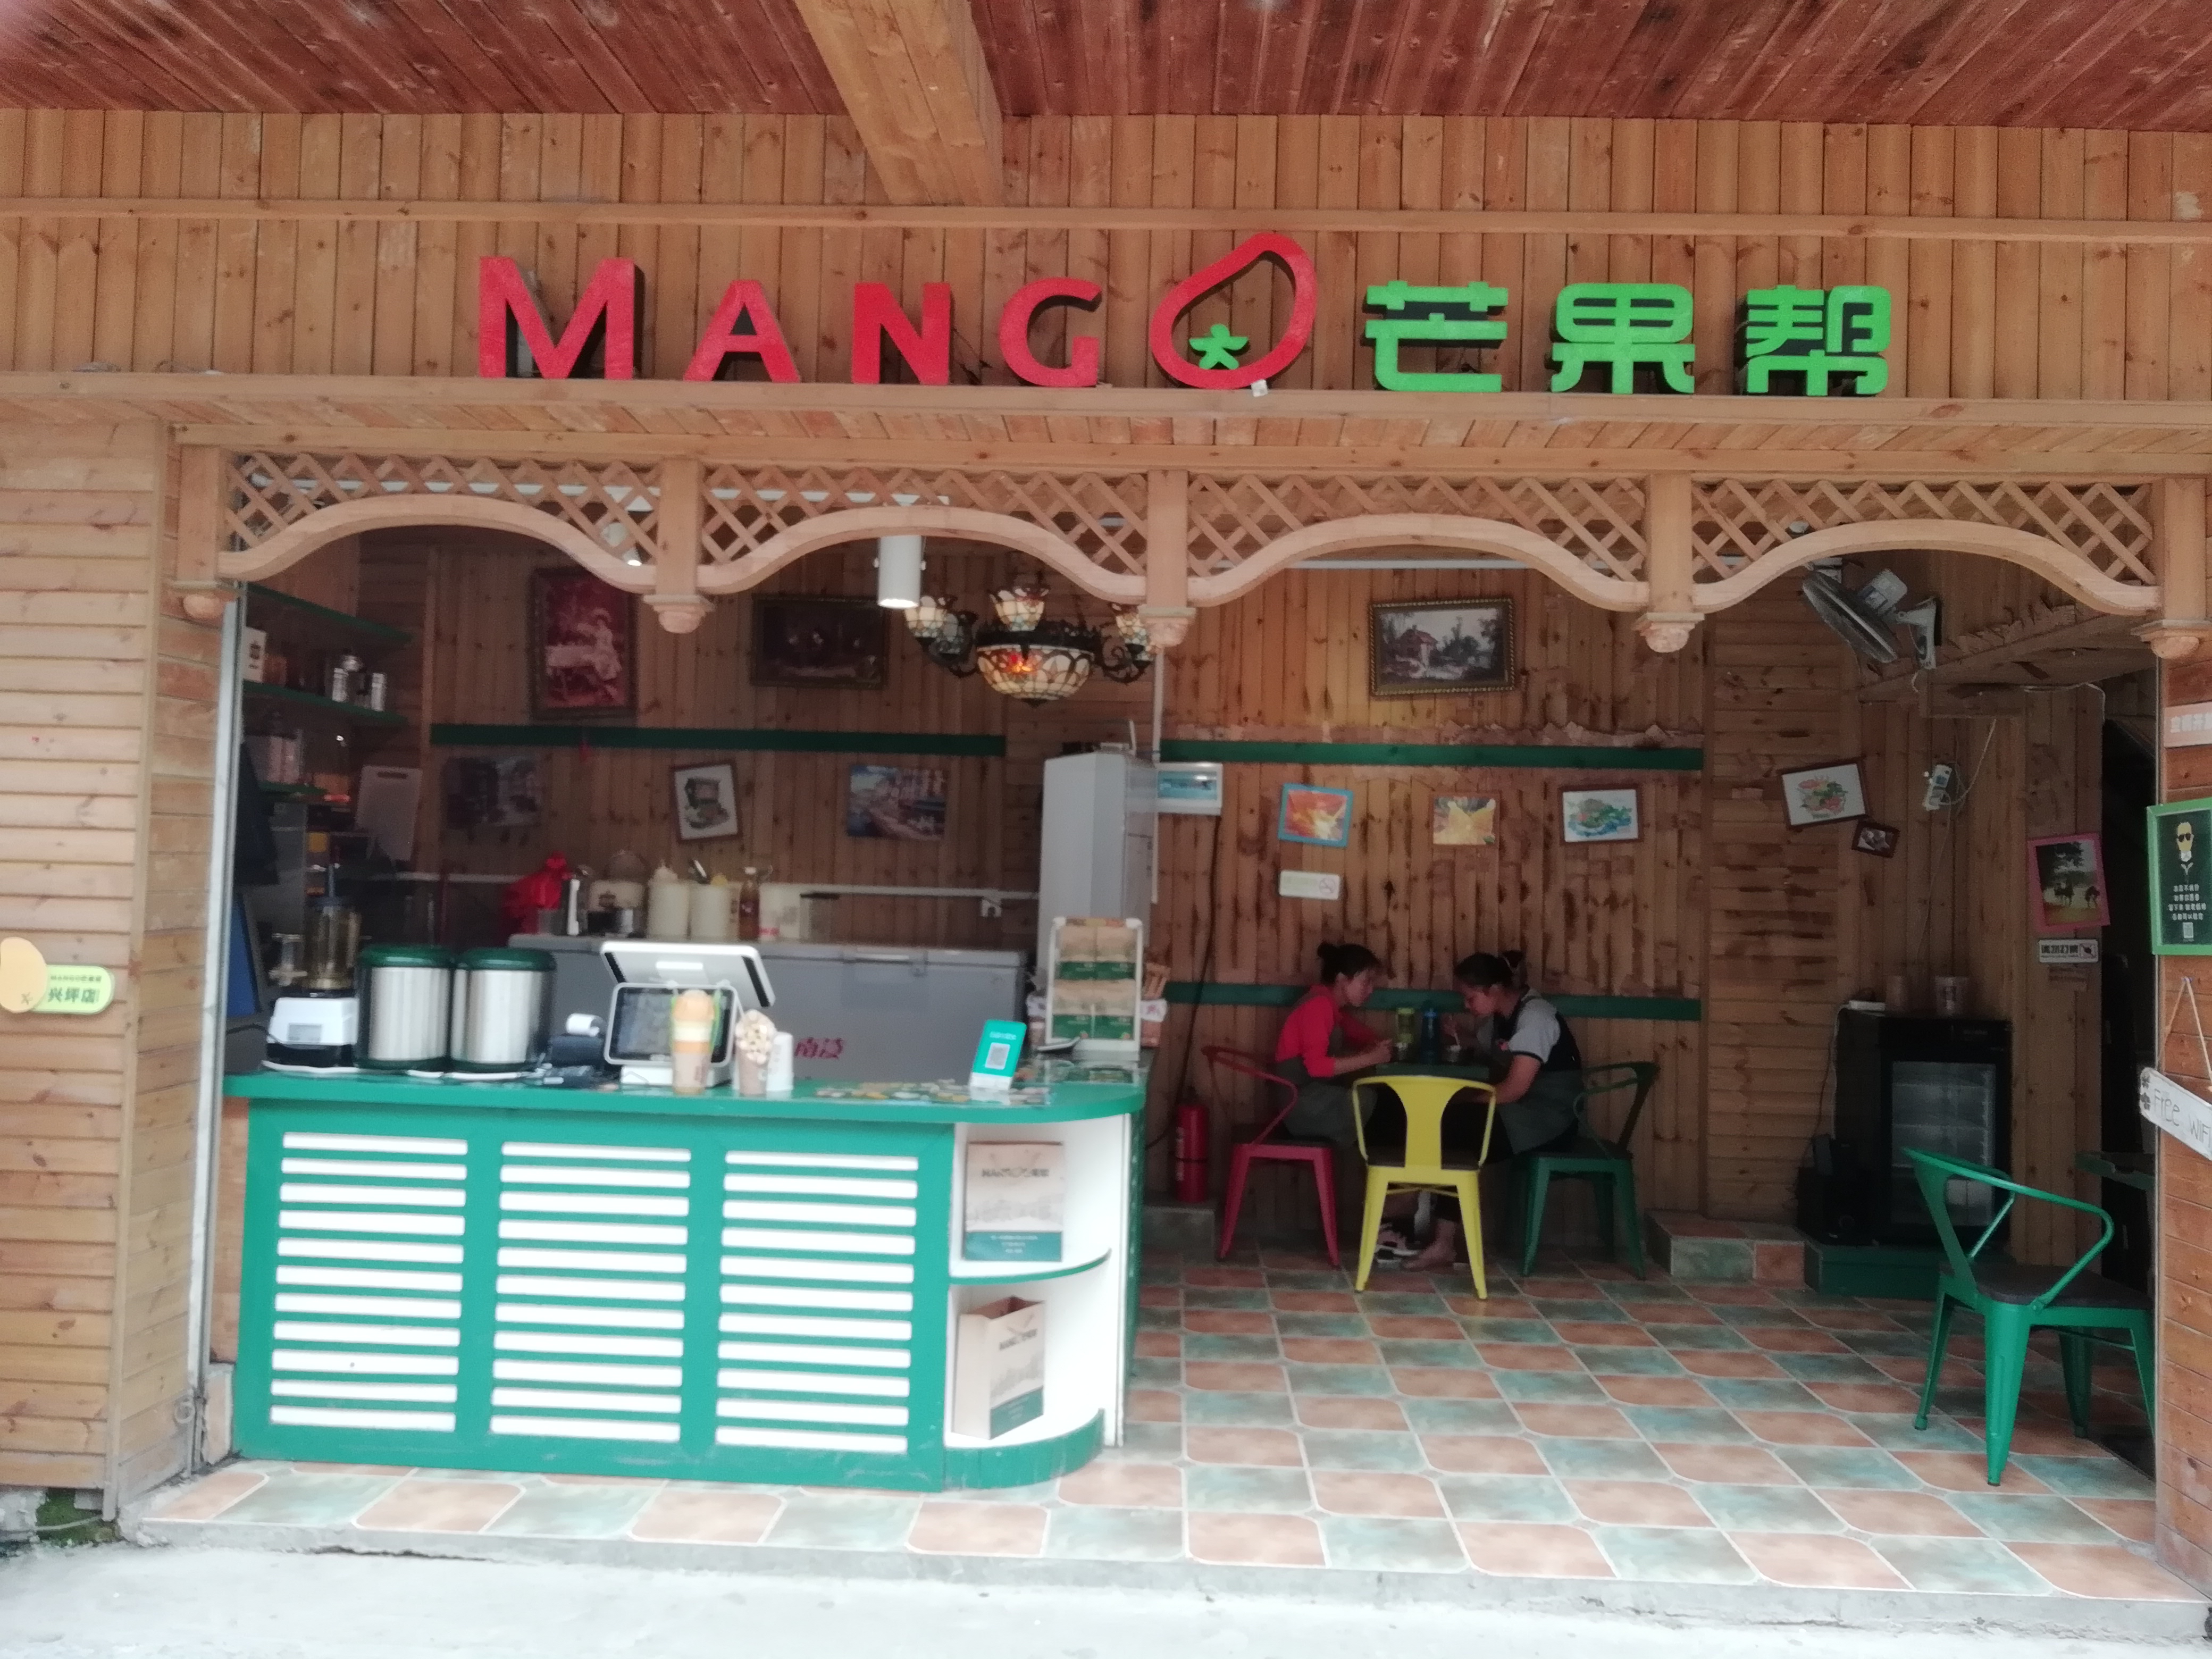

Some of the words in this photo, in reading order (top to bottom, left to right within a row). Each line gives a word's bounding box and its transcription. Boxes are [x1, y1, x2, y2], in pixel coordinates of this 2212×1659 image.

[1365, 280, 1891, 396] 芒果帮
[2154, 1088, 2180, 1127] Free
